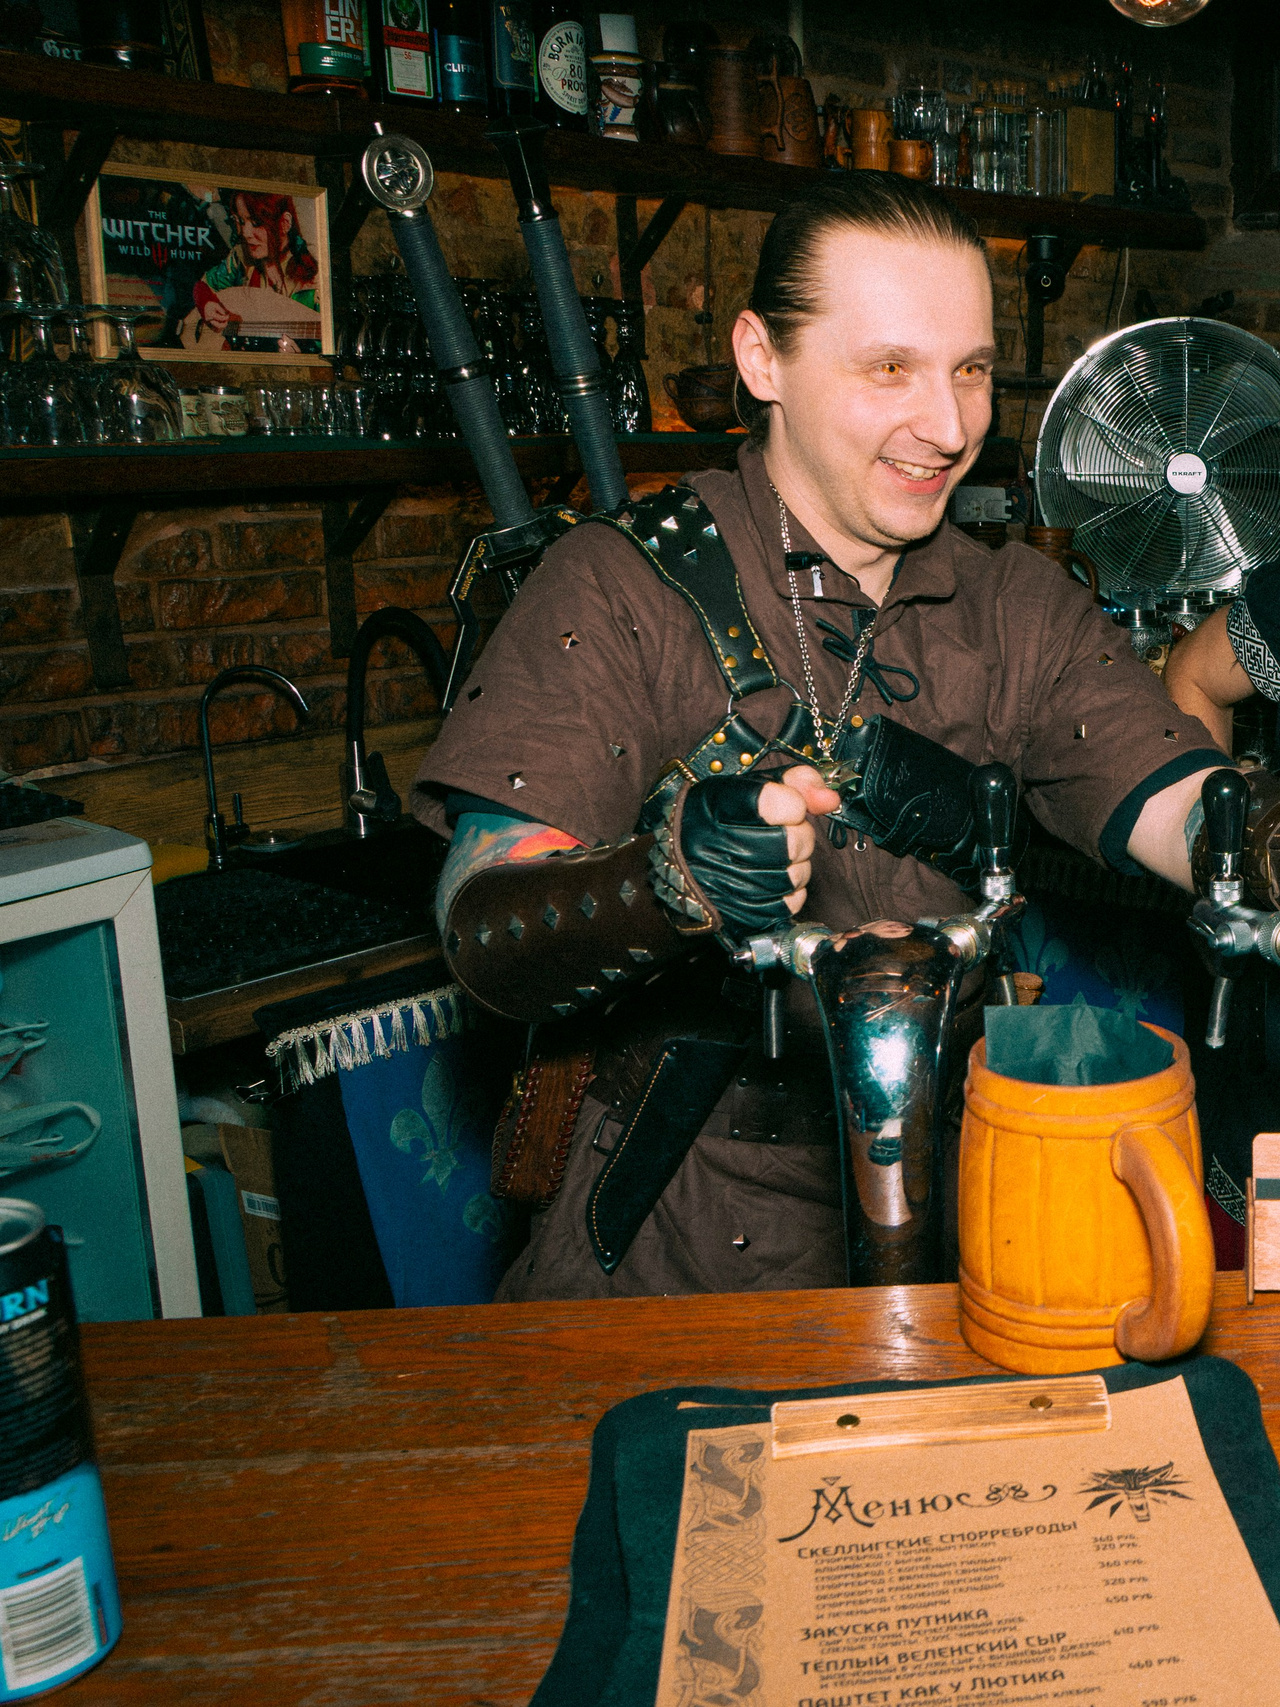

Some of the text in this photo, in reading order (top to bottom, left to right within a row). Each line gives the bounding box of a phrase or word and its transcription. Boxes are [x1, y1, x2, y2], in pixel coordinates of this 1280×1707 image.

[548, 31, 574, 61] BORN
[561, 80, 585, 93] PROO
[569, 63, 583, 80] 80
[148, 210, 167, 219] THE
[102, 217, 215, 250] WITCHER
[118, 244, 202, 261] WILD HUNT
[798, 1520, 1077, 1559] СКЕЛЛИГСКИЕ СМОРРЕБРОДЫ
[800, 1608, 988, 1641] ЗАКУСКА ПУТНИКА
[898, 1635, 1018, 1664] ВЕЛЕНСКИЙ
[1026, 1632, 1067, 1647] СЫР
[900, 1683, 940, 1700] КАК
[950, 1681, 961, 1693] У
[971, 1668, 1065, 1692] ЛЮТИКА
